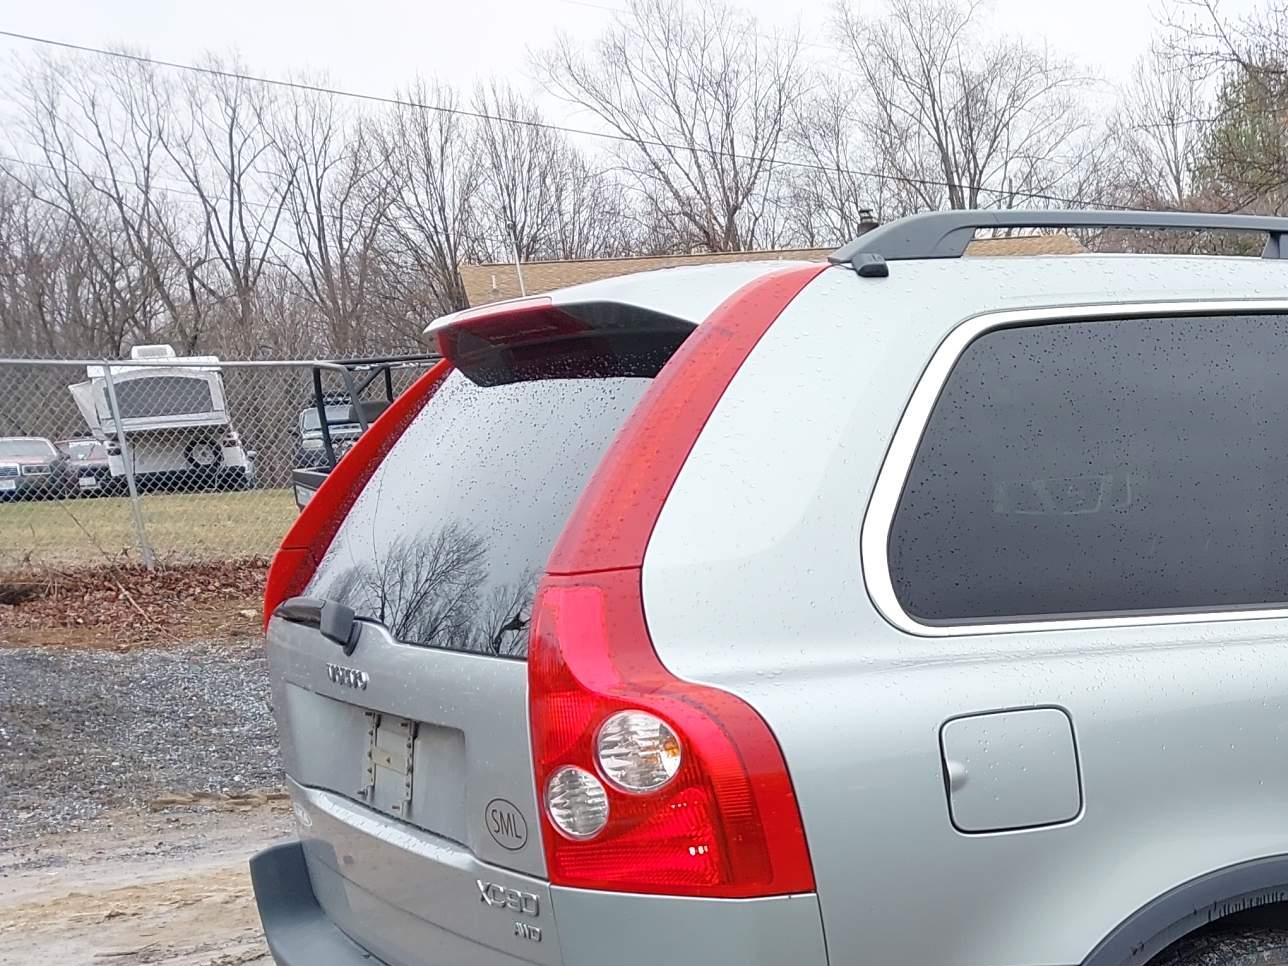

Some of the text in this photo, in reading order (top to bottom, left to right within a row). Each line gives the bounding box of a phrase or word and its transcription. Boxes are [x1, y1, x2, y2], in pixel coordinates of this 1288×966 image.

[326, 662, 370, 690] VOLVO
[491, 809, 522, 839] SML
[476, 879, 540, 917] XC90
[514, 922, 542, 942] AWD
